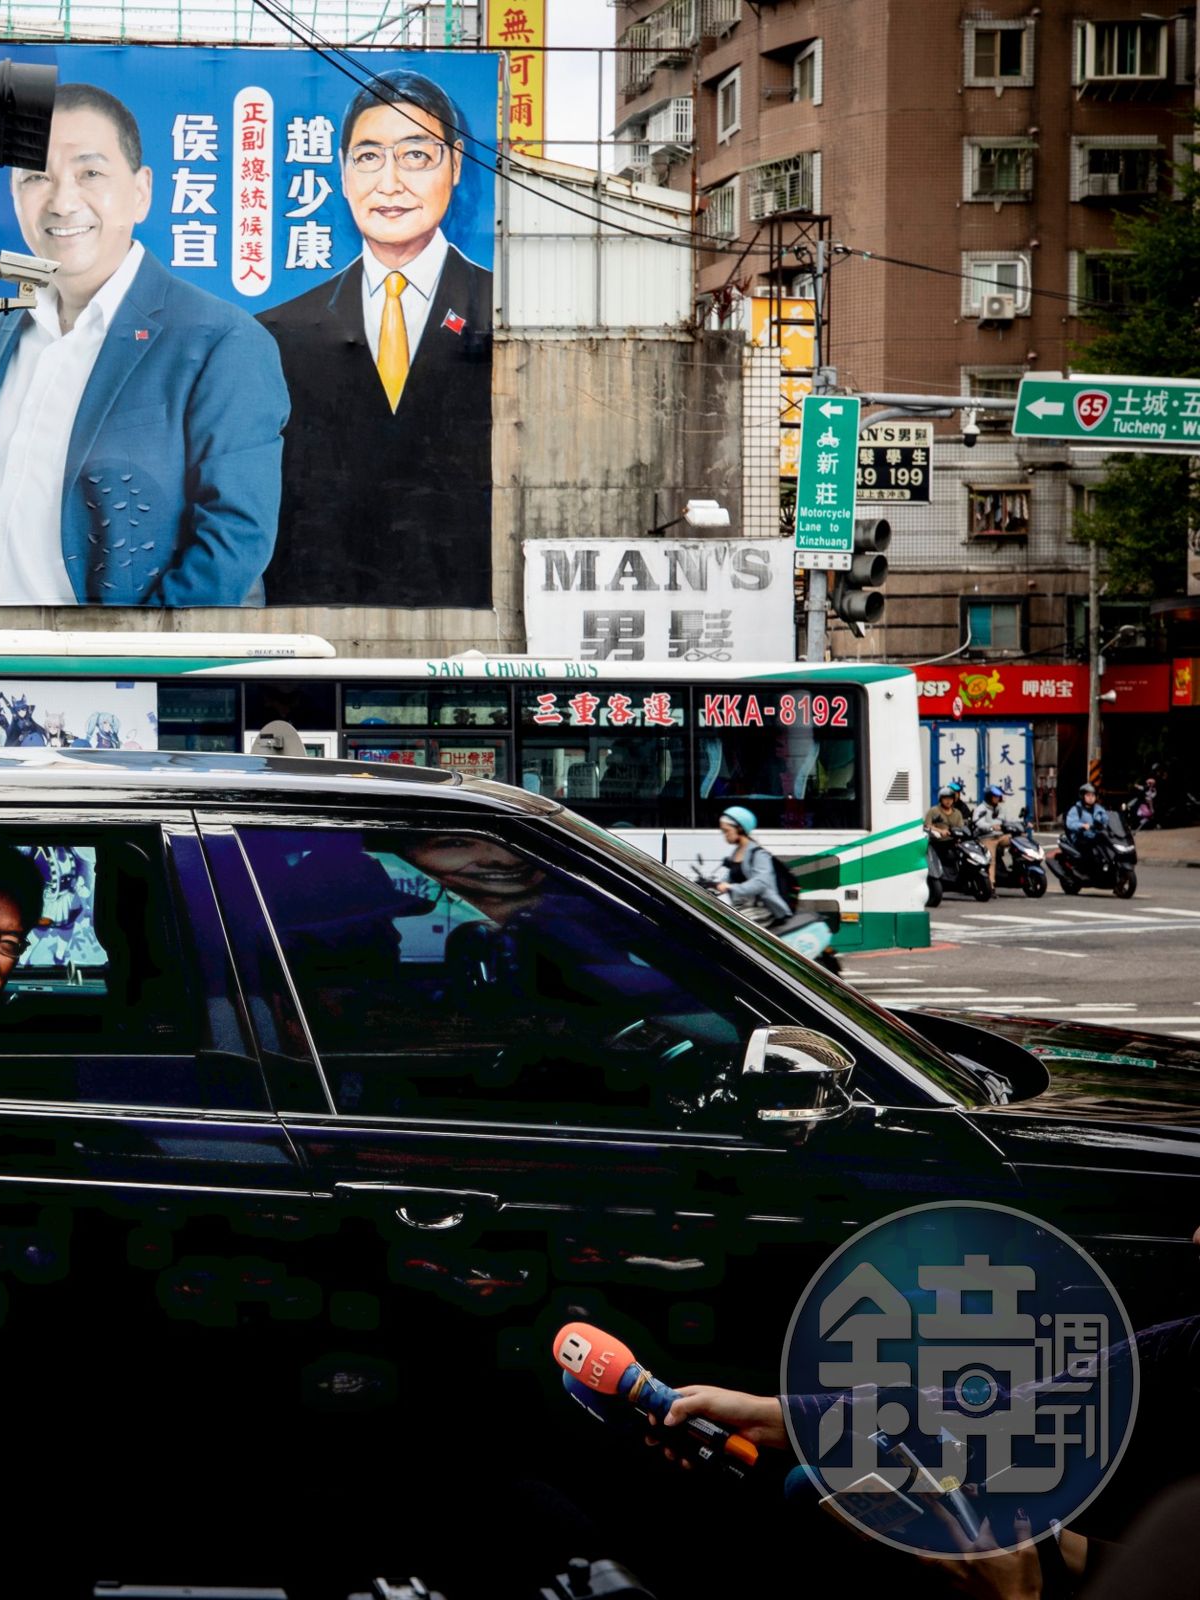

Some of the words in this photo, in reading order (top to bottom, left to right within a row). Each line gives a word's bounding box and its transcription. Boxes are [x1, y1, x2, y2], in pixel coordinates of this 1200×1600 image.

[171, 114, 218, 267] 侯友宜
[239, 102, 270, 281] 正副總統候選人
[285, 115, 335, 269] 趙少康
[1080, 398, 1103, 417] 65
[1113, 418, 1166, 439] Tucheng
[816, 452, 839, 505] 新莊
[889, 468, 923, 486] 199
[799, 522, 821, 531] Lane
[830, 523, 839, 532] to
[801, 507, 850, 520] Motorcycle
[799, 535, 848, 550] Xinzhuang
[541, 547, 774, 592] MAN'S
[427, 661, 464, 677] SAN
[485, 661, 546, 677] CHUNG
[565, 661, 598, 678] BUS
[1022, 680, 1074, 698] 呷尚宝
[534, 692, 676, 726] 三重客運
[704, 694, 848, 727] KKA-8192
[588, 1351, 615, 1387] udn
